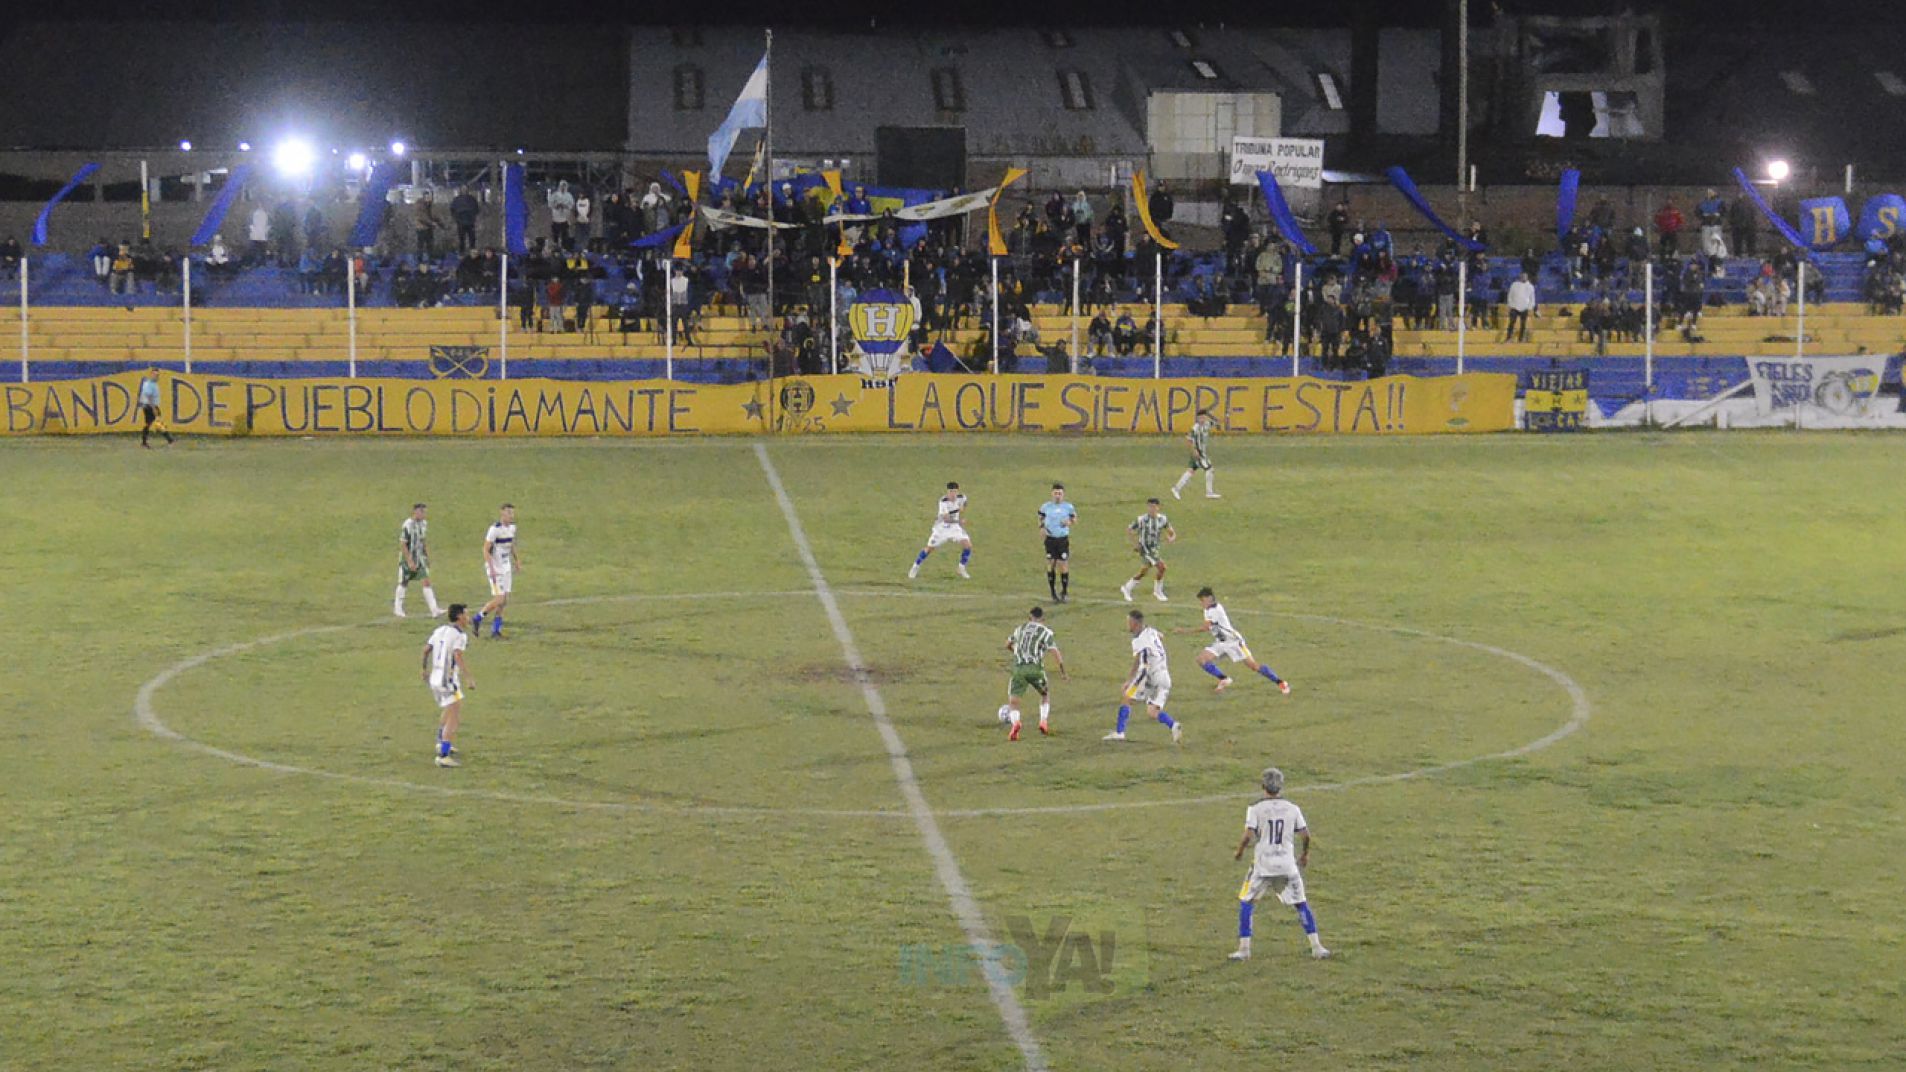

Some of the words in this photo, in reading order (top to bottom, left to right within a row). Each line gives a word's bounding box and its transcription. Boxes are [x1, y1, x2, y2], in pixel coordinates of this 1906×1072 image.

[1235, 142, 1272, 156] TRIBUNA
[1278, 144, 1320, 159] POPULAR
[1811, 206, 1837, 244] H
[863, 306, 899, 338] H
[171, 377, 234, 428] DE
[245, 383, 436, 434] PUEBLO
[887, 376, 946, 430] LA
[955, 381, 1045, 430] QUE
[1262, 383, 1405, 433] ESTA!!
[1267, 818, 1284, 845] 10
